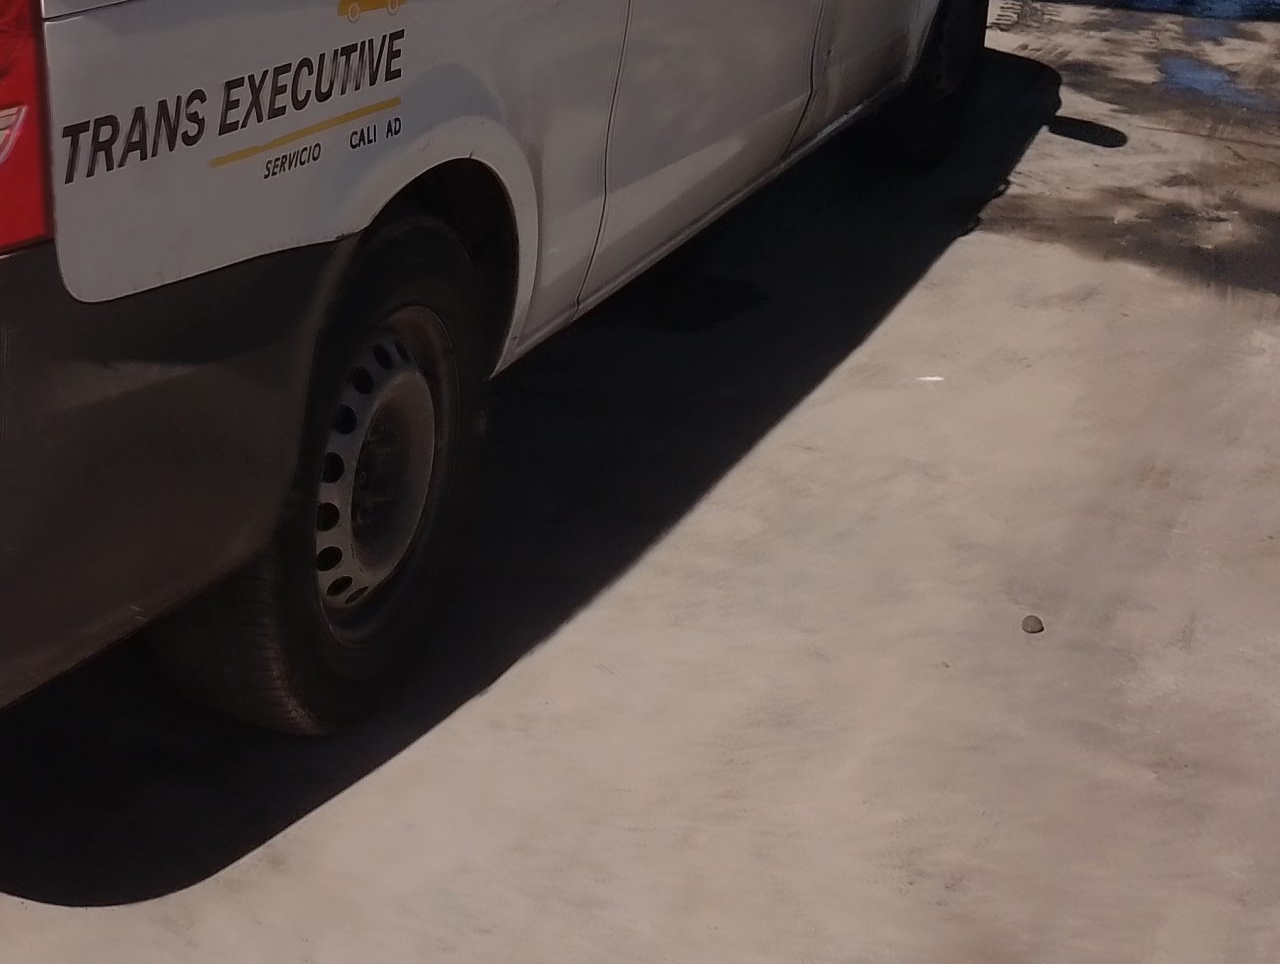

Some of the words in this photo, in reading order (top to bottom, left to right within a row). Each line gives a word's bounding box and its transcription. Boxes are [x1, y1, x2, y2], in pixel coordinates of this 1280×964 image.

[61, 88, 208, 185] TRANS
[217, 28, 406, 136] EXECUTIVE
[263, 142, 322, 179] SERVICIO
